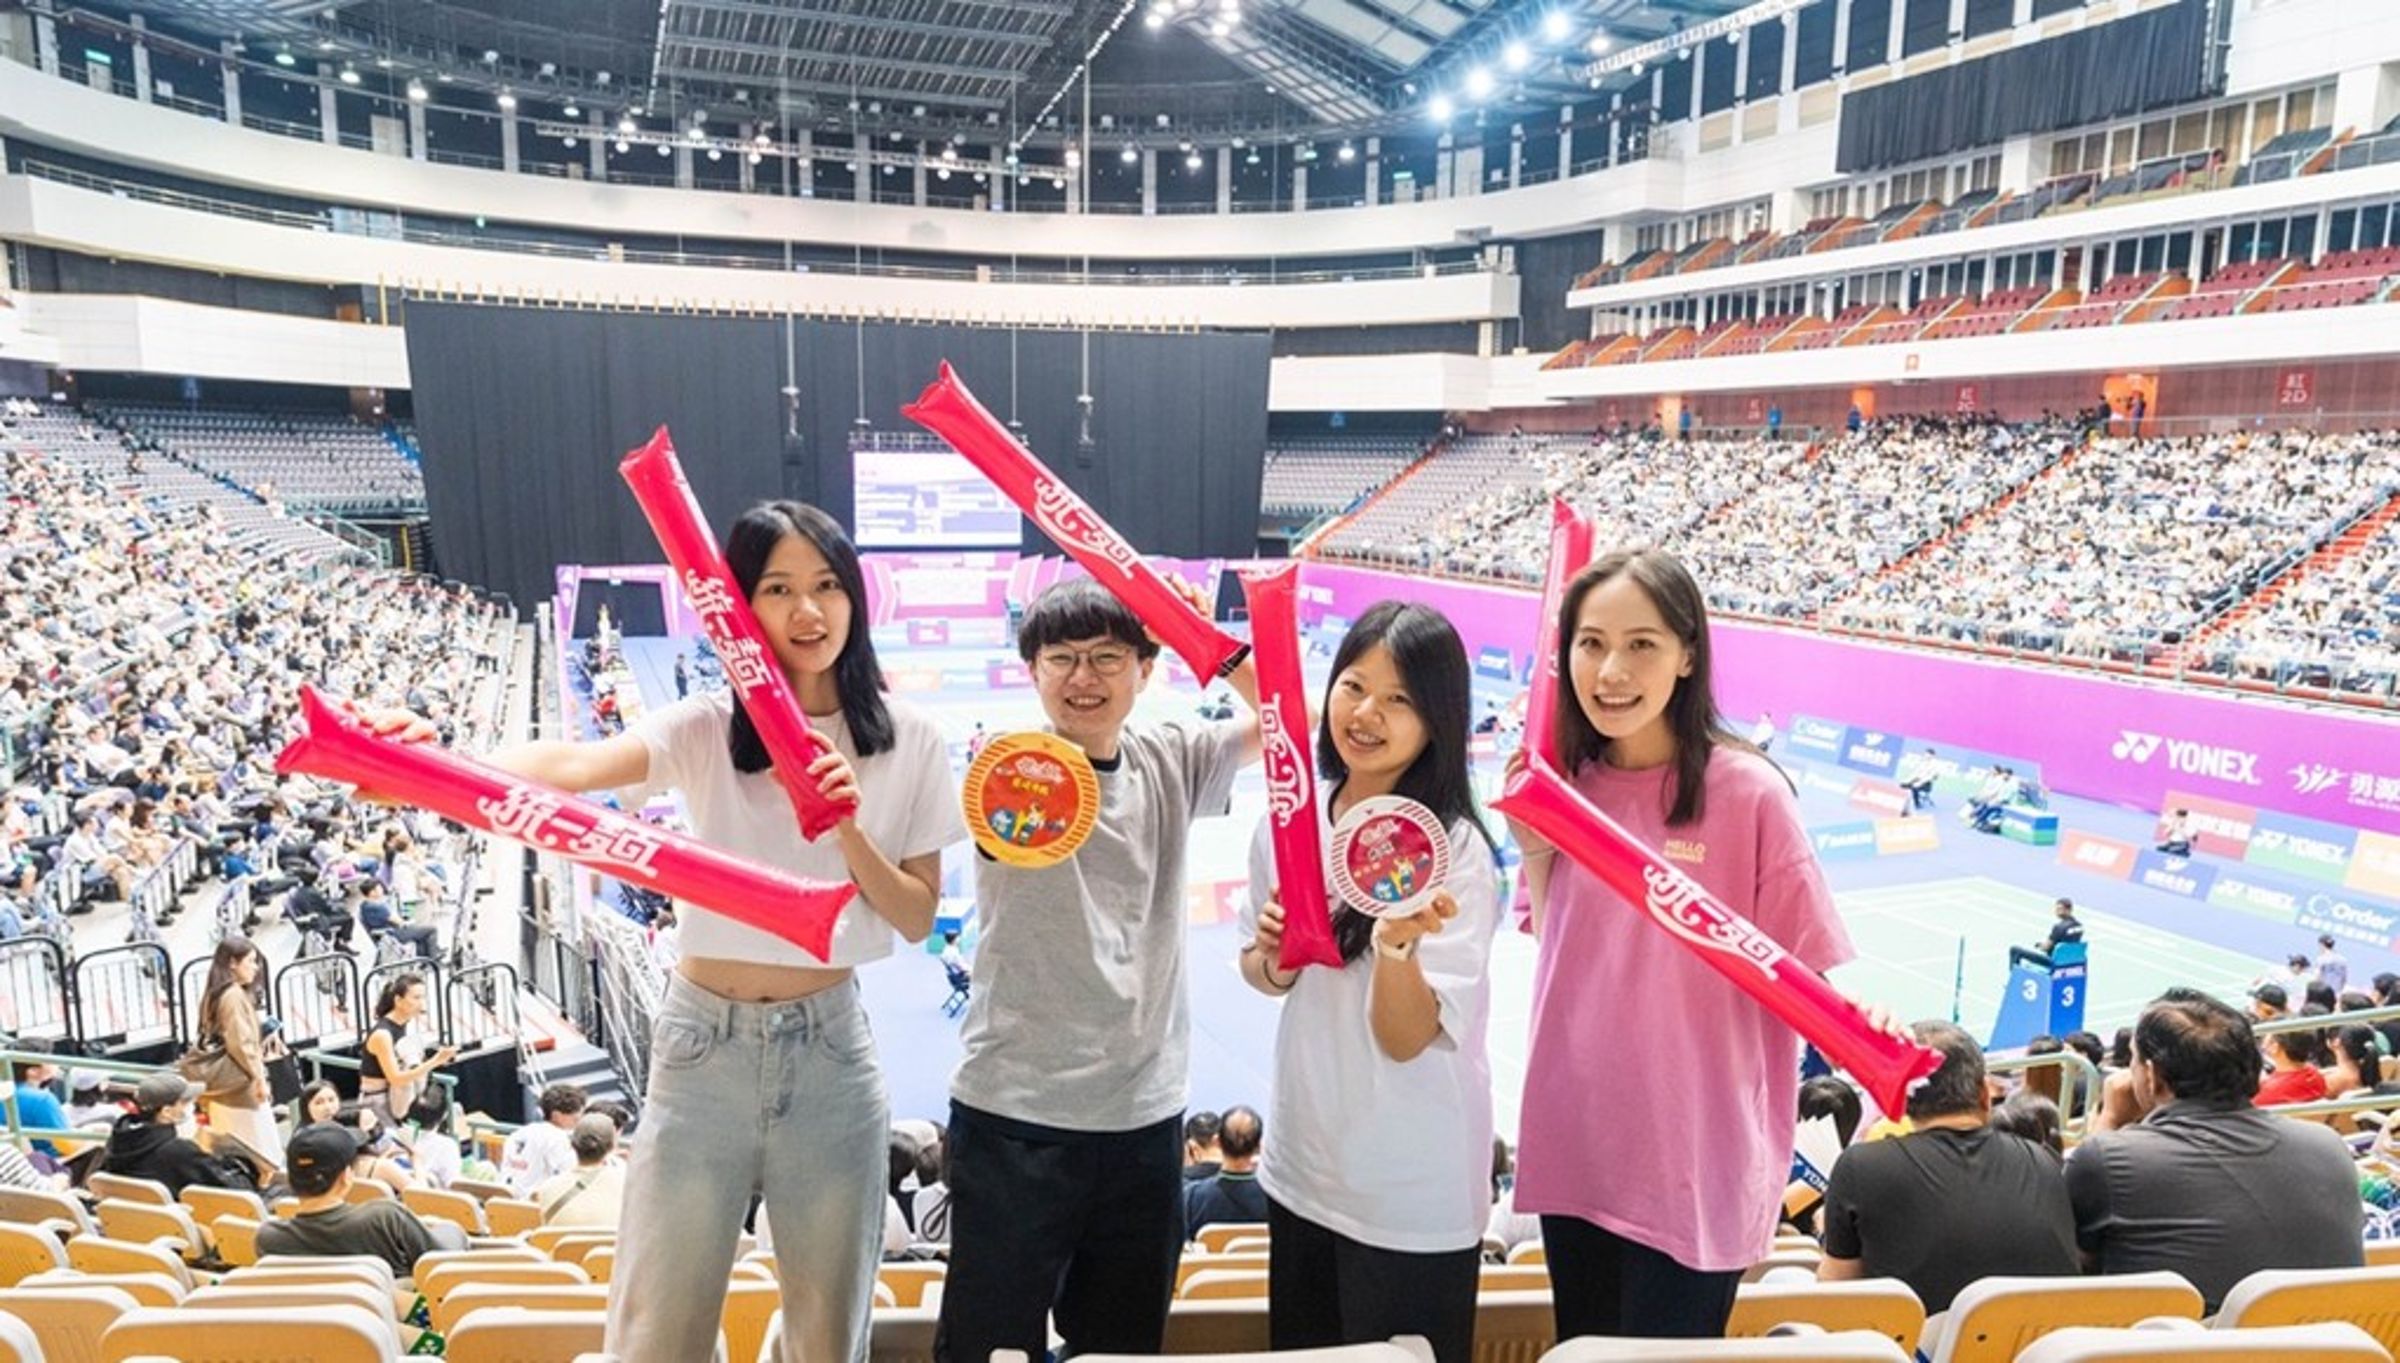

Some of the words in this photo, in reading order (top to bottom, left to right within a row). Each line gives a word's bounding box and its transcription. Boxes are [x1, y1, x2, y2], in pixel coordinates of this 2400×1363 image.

[2280, 390, 2308, 404] 2D
[2166, 738, 2259, 785] YONEX
[476, 785, 662, 879] 統一麵
[2288, 835, 2347, 864] YONEX
[2021, 979, 2038, 1002] 3
[2061, 985, 2076, 1007] 3
